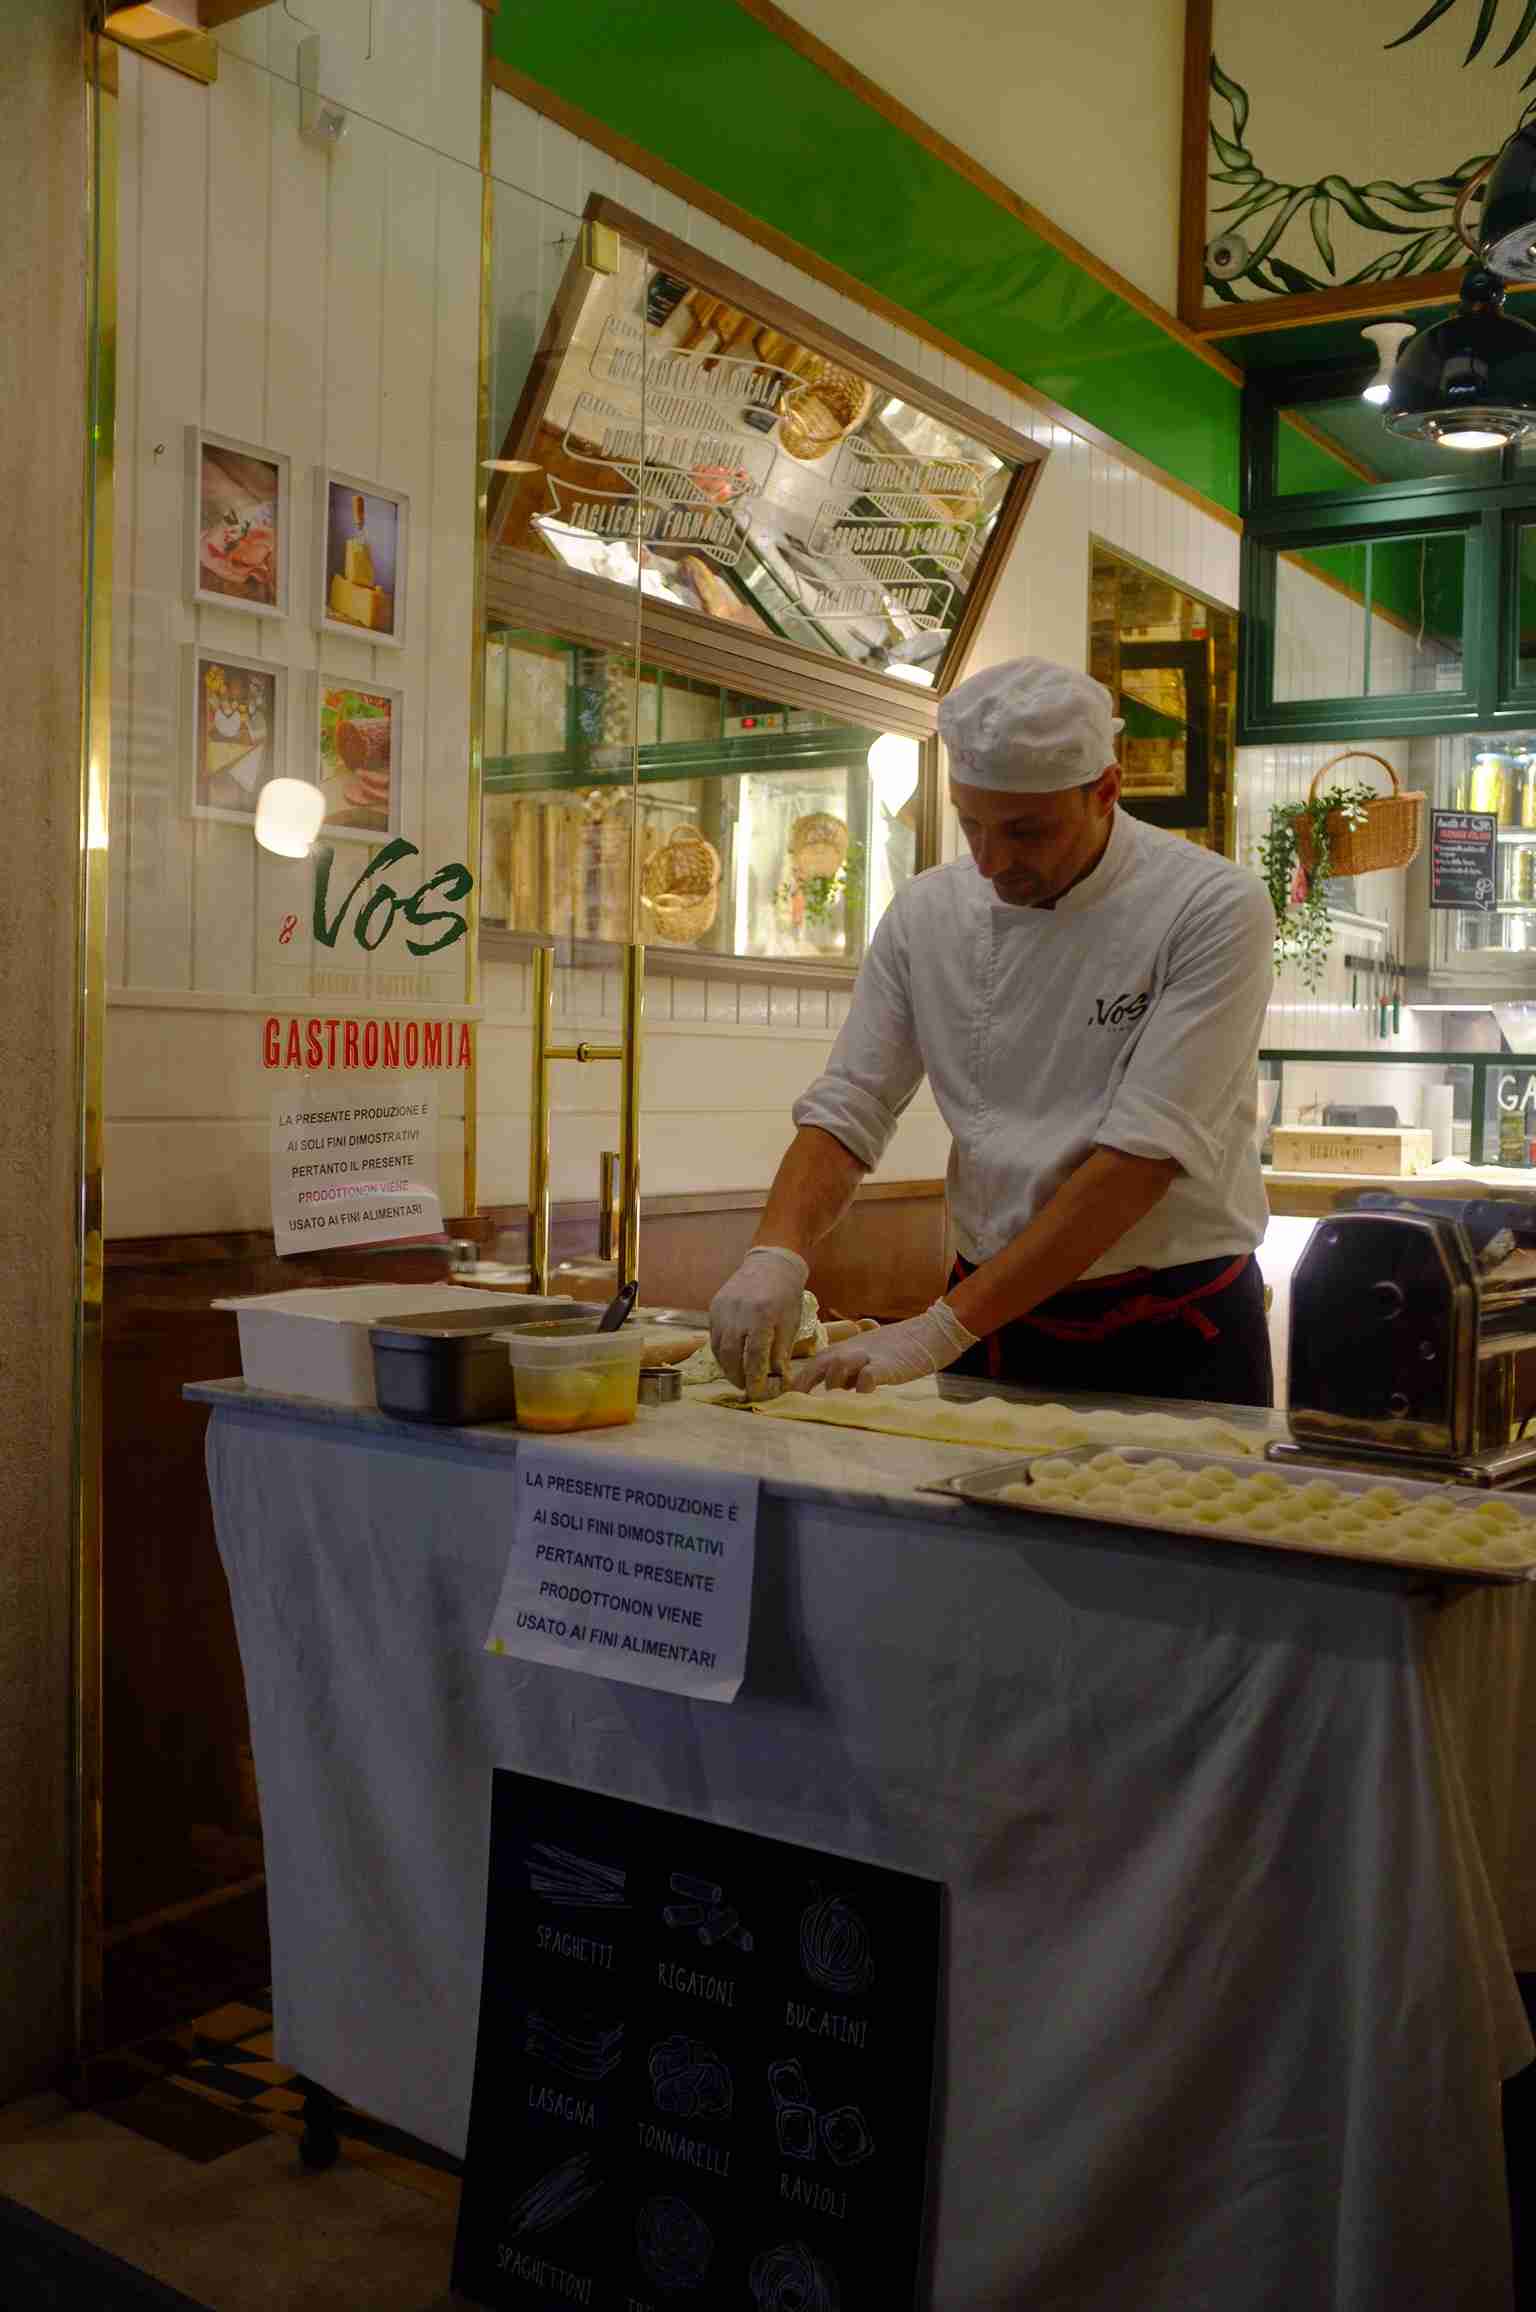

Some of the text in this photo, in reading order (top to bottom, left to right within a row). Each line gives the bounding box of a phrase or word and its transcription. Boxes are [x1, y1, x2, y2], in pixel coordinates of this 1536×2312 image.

[263, 1017, 471, 1069] GASTRONOMIA
[279, 1112, 292, 1126] LA
[296, 1109, 351, 1125] PRESENTE
[353, 1104, 420, 1121] PRODUZIONE
[287, 1128, 421, 1152] AI SOLI FINI DIMOSTRATIVI
[291, 1153, 416, 1178] PERTANTO IL PRESENTE
[288, 1202, 423, 1232] USATO AI FINI ALIMENTARI
[525, 1471, 544, 1488] LA
[547, 1474, 622, 1503] PRESENTE
[624, 1487, 725, 1520] PRODUZIONE
[533, 1508, 725, 1558] AI SOLI FINI DIMOSTRATIVI
[535, 1544, 716, 1594] PERTANTO IL PRESENTE
[539, 1581, 705, 1629] PRODOTTONON VIENE
[516, 1612, 718, 1670] USATO AI FINI ALIMENTARI
[534, 1923, 617, 1969] SPAGHETTI
[656, 1961, 737, 2008] RIGATONI
[783, 1999, 868, 2049] BUCATINI
[528, 2083, 597, 2129] LASAGNA
[637, 2120, 730, 2177] TONNARELLI
[778, 2172, 847, 2220] RAVIOLI
[496, 2242, 592, 2305] SPAGHETTONI
